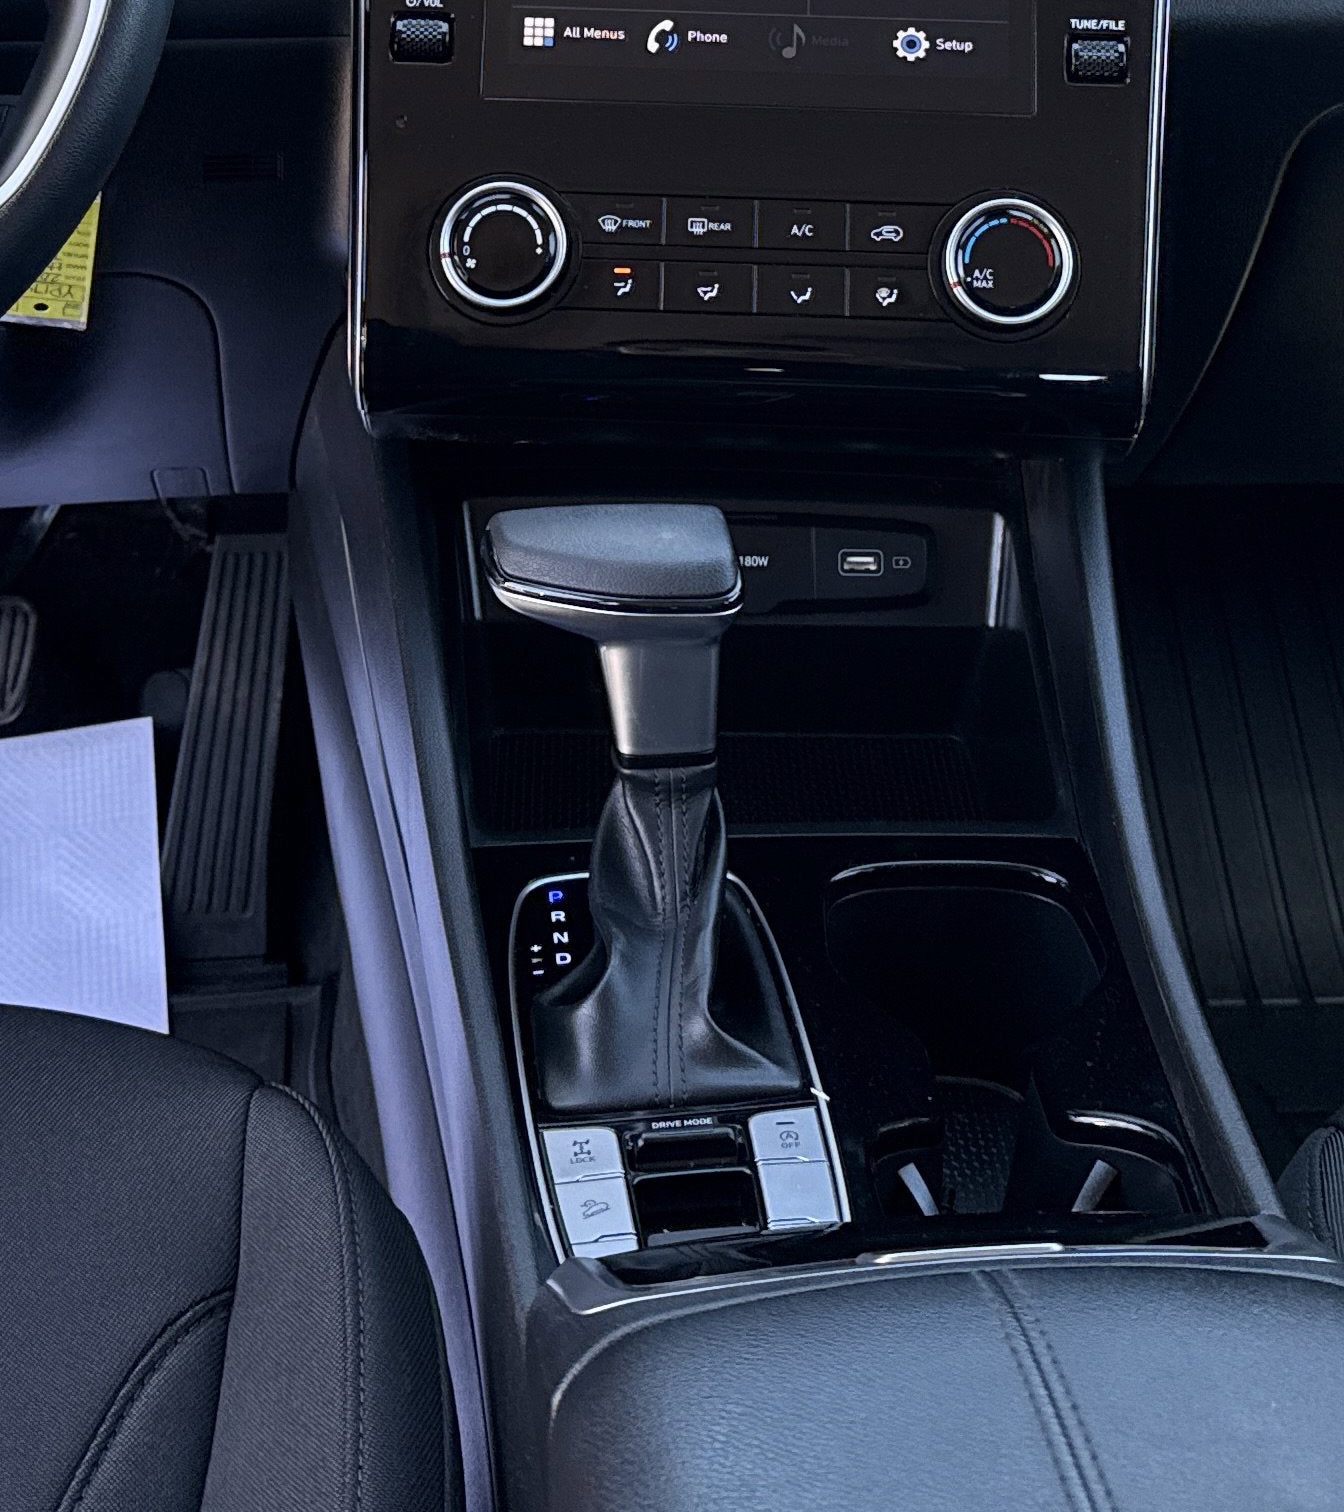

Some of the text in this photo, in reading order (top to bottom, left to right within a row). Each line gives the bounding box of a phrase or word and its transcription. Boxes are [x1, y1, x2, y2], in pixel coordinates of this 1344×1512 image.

[1070, 18, 1126, 31] TUNE/FILE
[563, 27, 625, 39] All Menus
[687, 31, 728, 43] Phone
[812, 37, 849, 47] Media
[935, 38, 973, 53] Setup
[622, 219, 652, 228] FRONT
[708, 222, 731, 231] REAR
[790, 224, 814, 237] A/C
[973, 268, 994, 280] A/C
[973, 280, 994, 288] MAX
[739, 555, 769, 567] 180W
[548, 890, 564, 904] P
[550, 910, 566, 923] R
[552, 931, 569, 944] N
[555, 952, 572, 965] D
[651, 1117, 713, 1130] DRIVE MODE
[780, 1141, 801, 1149] OFF
[570, 1156, 596, 1165] LOCK
